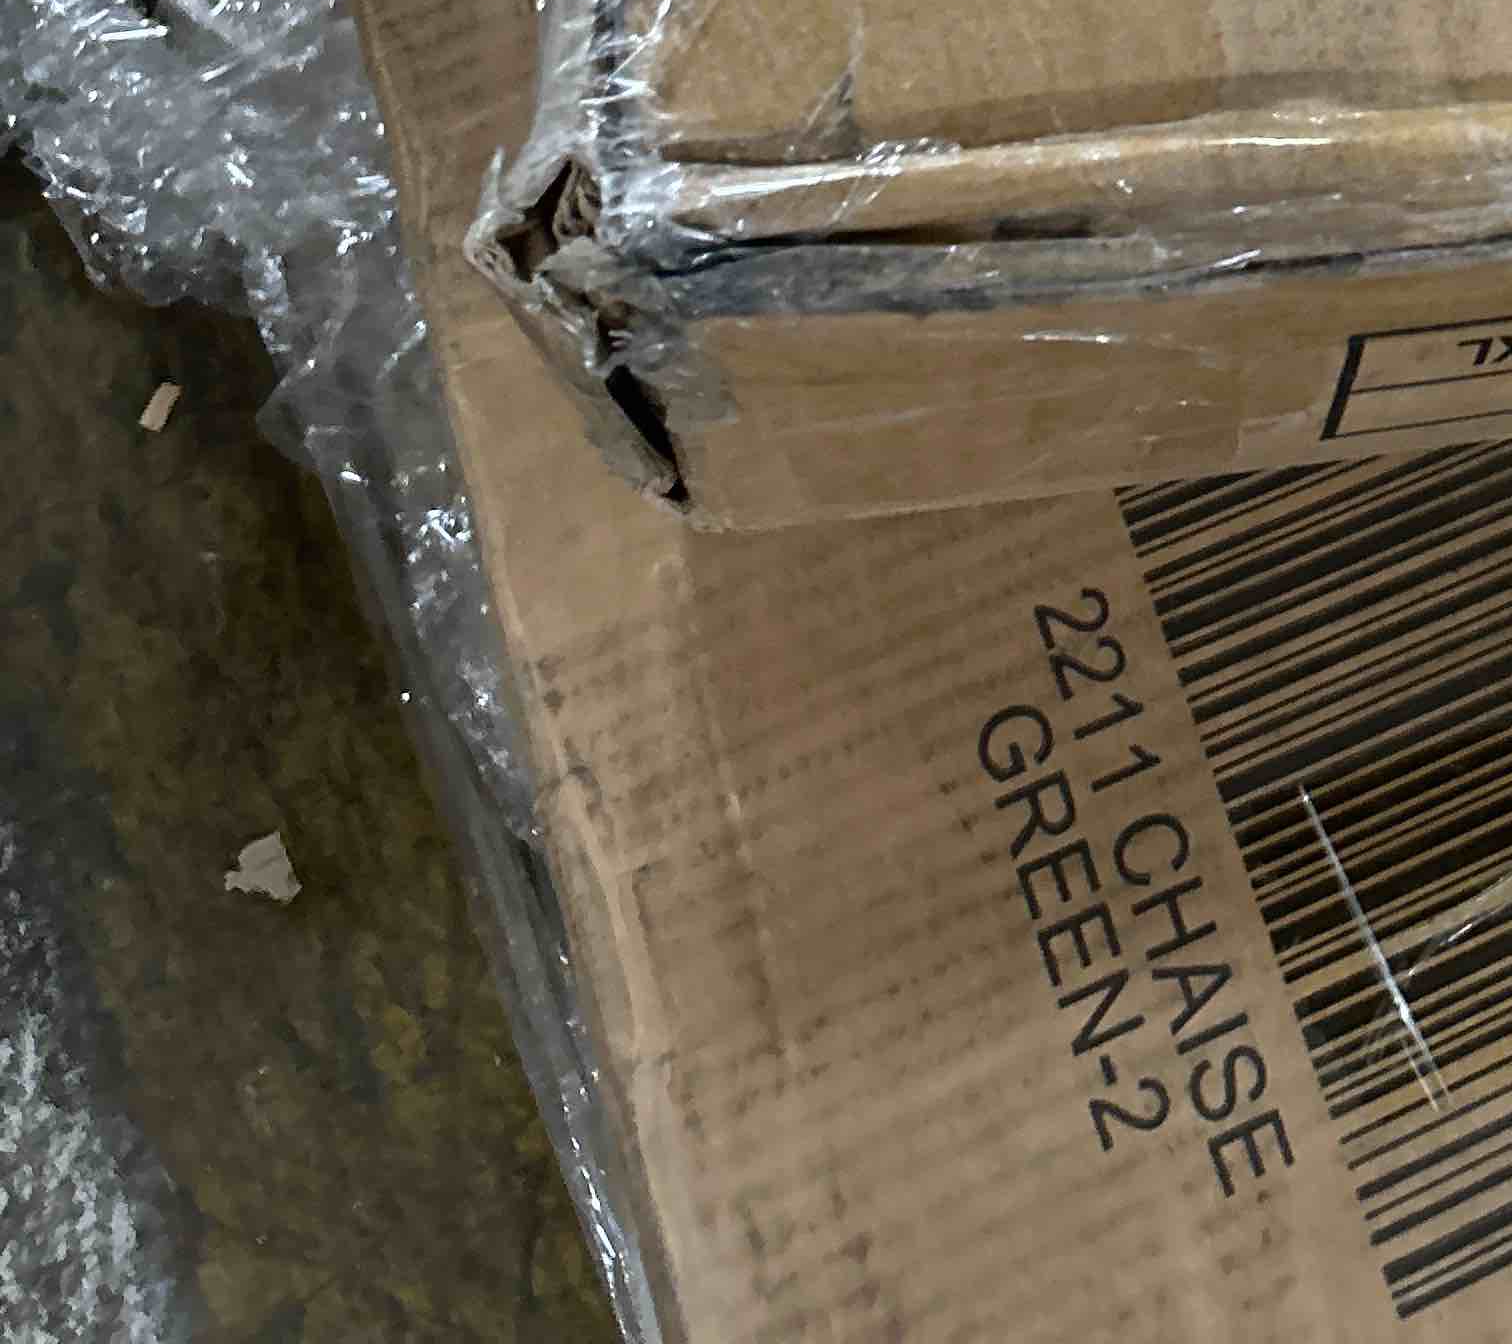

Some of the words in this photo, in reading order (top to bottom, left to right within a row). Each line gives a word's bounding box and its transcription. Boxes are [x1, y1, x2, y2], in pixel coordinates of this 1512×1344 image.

[978, 704, 1171, 1152] GREEN-2
[1034, 587, 1161, 793] 2211
[1113, 813, 1294, 1198] CHAISE
